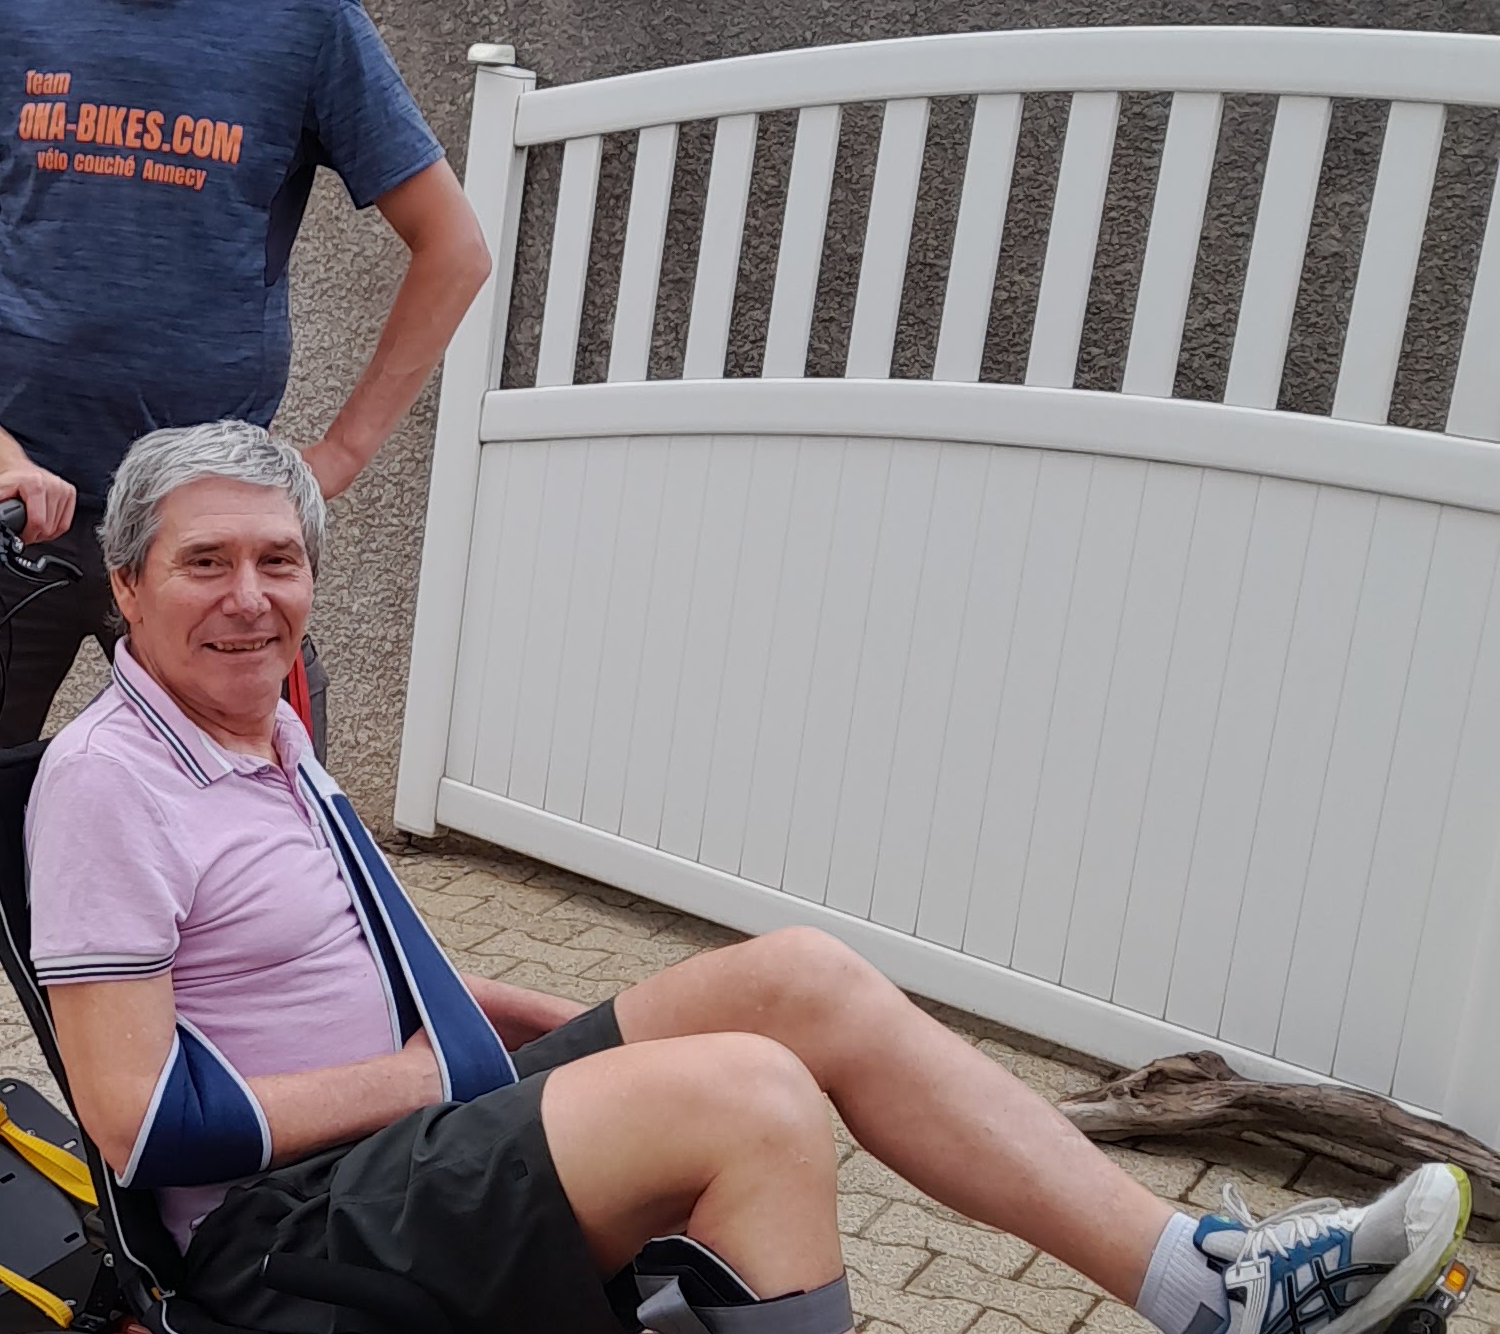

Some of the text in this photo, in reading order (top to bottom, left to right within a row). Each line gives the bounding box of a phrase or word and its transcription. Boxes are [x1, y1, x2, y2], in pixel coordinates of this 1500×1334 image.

[26, 69, 71, 95] Team
[37, 147, 207, 190] vélo couché Annecy
